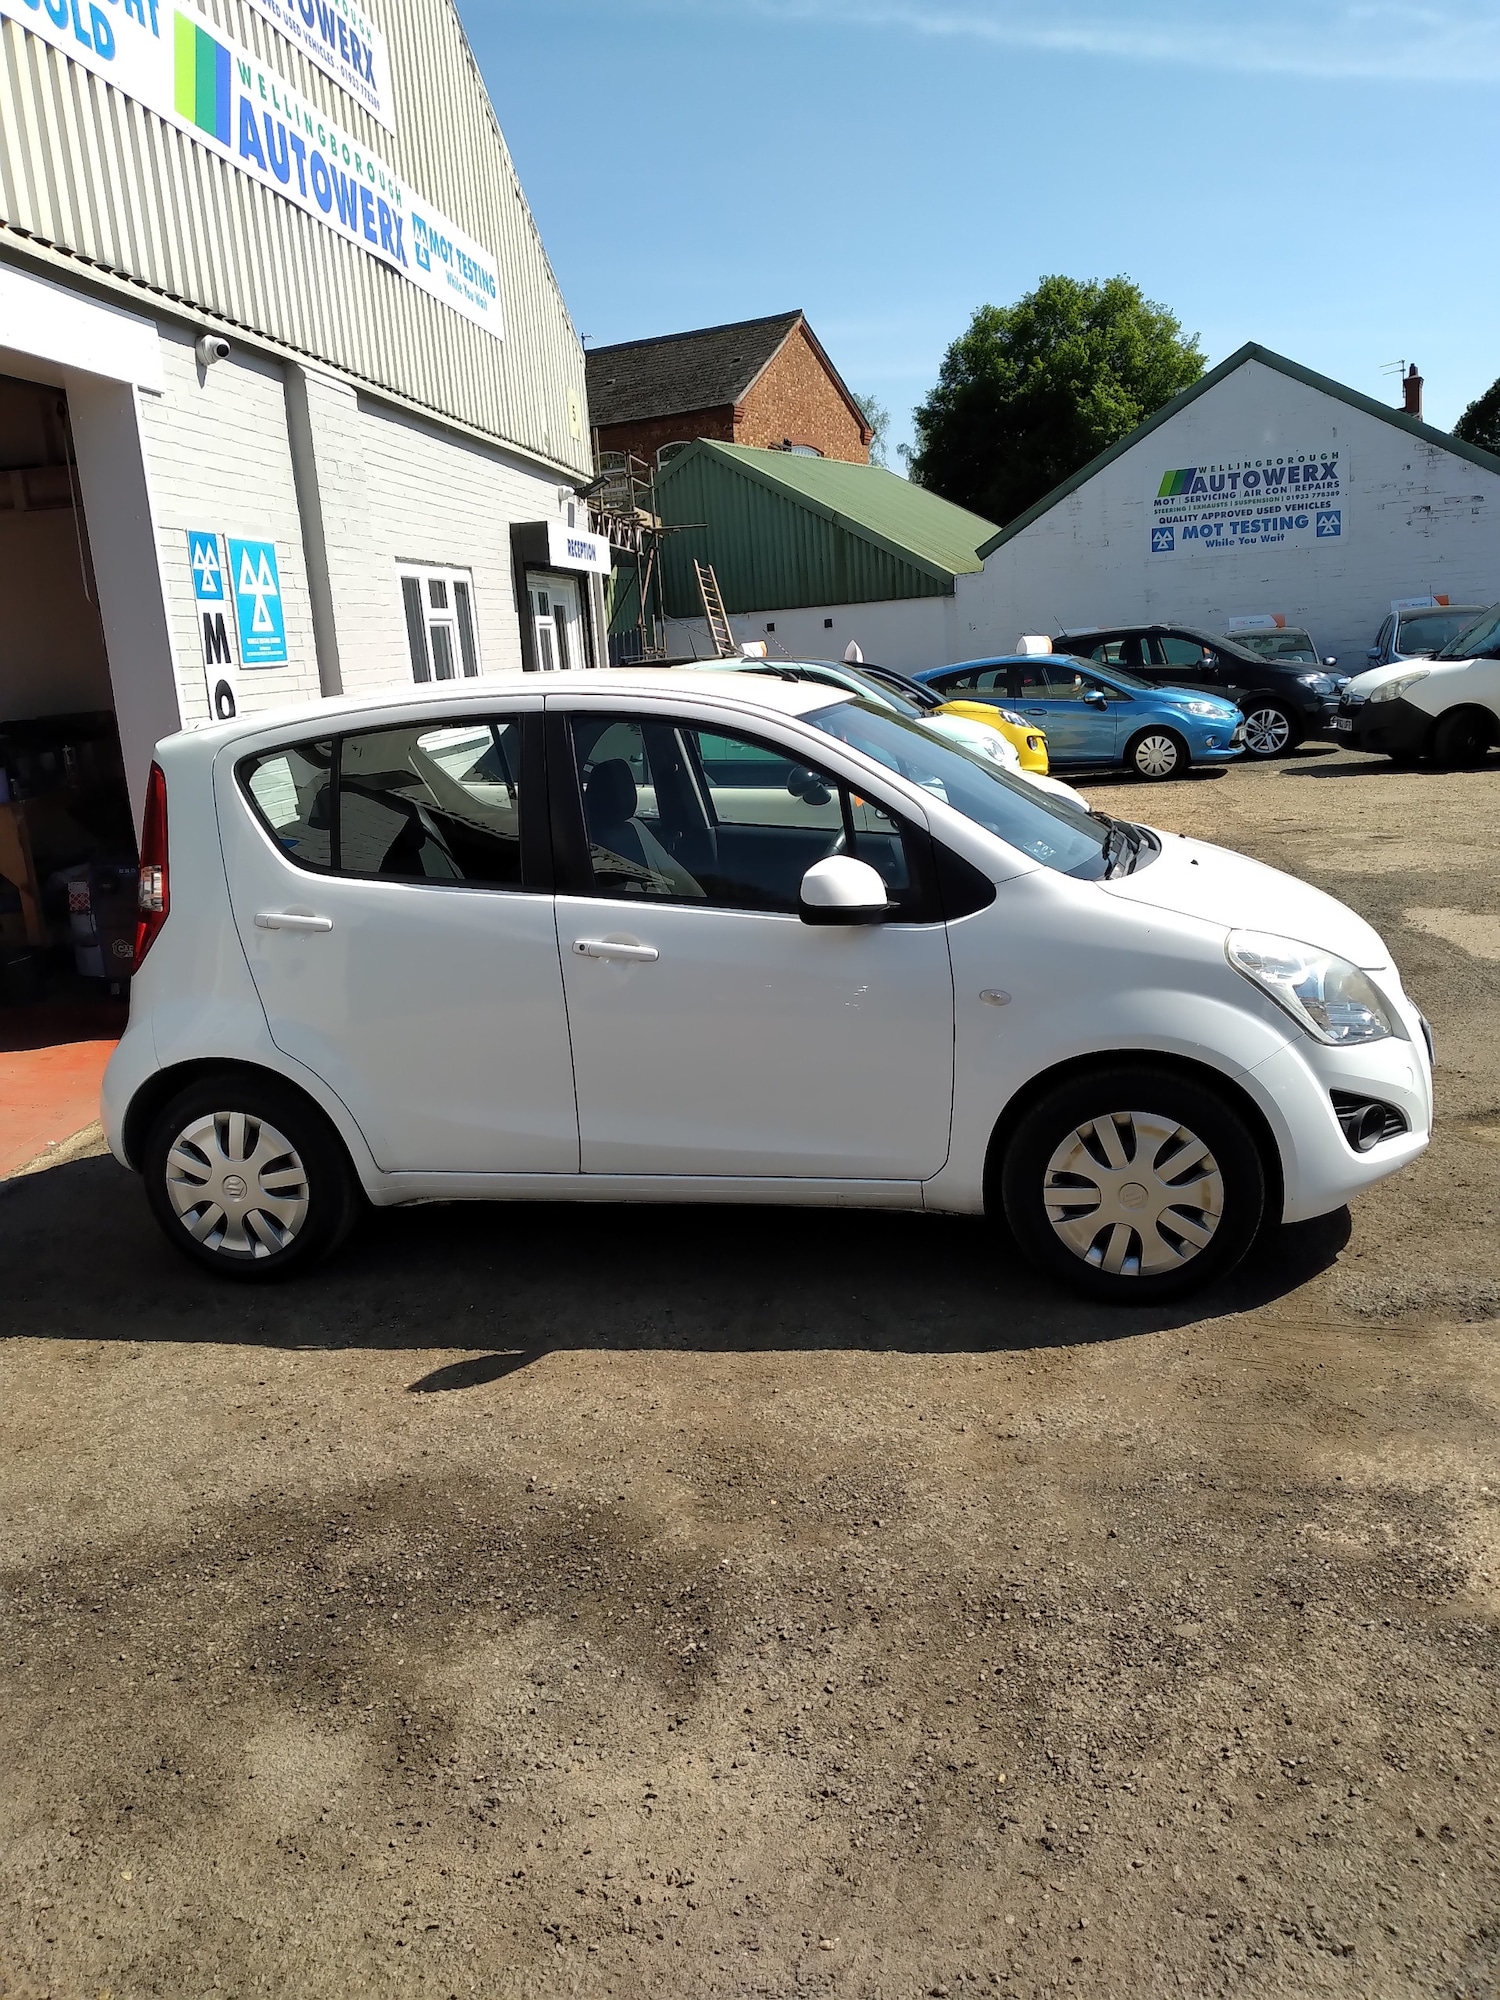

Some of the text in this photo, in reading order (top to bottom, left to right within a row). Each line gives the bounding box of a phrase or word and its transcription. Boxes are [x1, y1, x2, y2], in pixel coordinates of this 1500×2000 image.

[23, 0, 116, 61] OLD
[283, 11, 301, 37] USED
[303, 29, 334, 68] VEHICLES
[287, 0, 377, 92] OWERX
[236, 56, 402, 208] WELLINGBOROUGH
[239, 94, 409, 269] AUTOWERX
[429, 226, 496, 299] MOT TESTING
[445, 269, 462, 294] While
[463, 282, 474, 302] You
[1190, 461, 1339, 495] AUTOWERX
[1198, 451, 1339, 474] WELLINGBOROUGH
[1153, 480, 1340, 507] MOT SERVICING AIR CON REPAIRS
[1154, 506, 1187, 515] STEERING
[1193, 501, 1228, 511] EXHAUSTS
[1234, 496, 1280, 506] SUSPENSION
[1311, 490, 1340, 498] 778389
[1159, 500, 1332, 525] QUALITY APPROVED USED VEHICLES
[1182, 514, 1309, 540] MOT TESTING
[566, 538, 597, 562] RECEPTION
[1205, 533, 1285, 548] While You Wait
